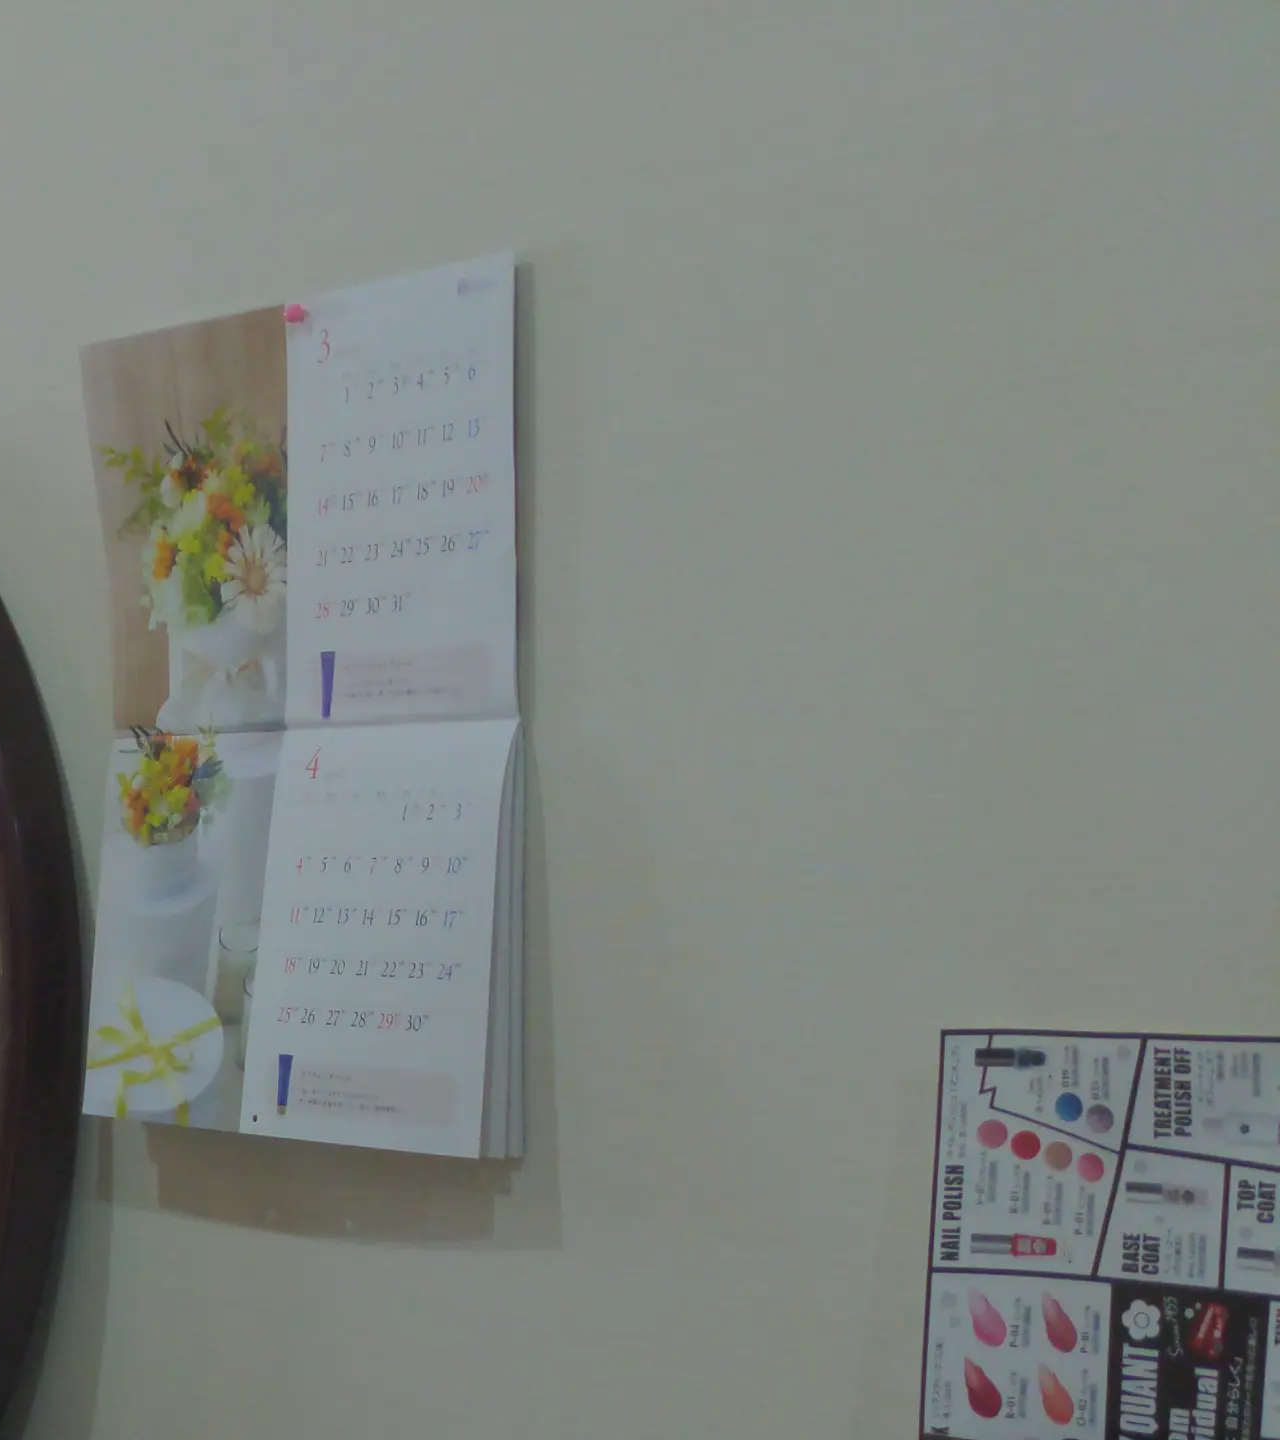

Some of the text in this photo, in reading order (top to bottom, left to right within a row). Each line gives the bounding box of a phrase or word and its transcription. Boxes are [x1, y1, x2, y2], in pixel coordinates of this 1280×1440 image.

[316, 328, 332, 364] 3
[366, 381, 375, 399] 2
[392, 377, 400, 395] 3
[415, 373, 425, 390] 4
[441, 366, 450, 386] 5
[467, 365, 477, 382] 6
[343, 440, 352, 457] 8
[367, 435, 377, 454] 9
[391, 430, 405, 451] 10
[416, 427, 429, 447] 11
[441, 423, 454, 442] 12
[466, 419, 481, 439] 13
[340, 492, 356, 512] 15
[366, 489, 380, 507] 16
[391, 486, 404, 504] 17
[416, 482, 430, 501] 18
[441, 479, 456, 498] 19
[465, 475, 483, 495] 20
[315, 531, 482, 567] 21 22 23 24 25 26 27
[314, 594, 404, 620] 28 29 30 31
[304, 746, 322, 780] 4
[400, 802, 462, 822] 1 2 3
[295, 856, 463, 876] 4 5 6 7 8 9 10
[288, 906, 457, 929] 11 12 13 14 15 16 17
[283, 956, 454, 982] 18 19 20 21 22 23 24
[276, 1006, 423, 1033] 25 26 27 28 29 30
[1153, 1046, 1173, 1139] TREATMENT
[1173, 1047, 1192, 1139] POLISH OFF
[943, 1163, 966, 1221] POLISH
[1237, 1178, 1255, 1211] TOP
[1257, 1180, 1277, 1225] COAT
[940, 1223, 960, 1263] NAIL
[1121, 1231, 1141, 1273] BASE
[1141, 1232, 1161, 1276] COAT
[1119, 1342, 1159, 1435] QUANT
